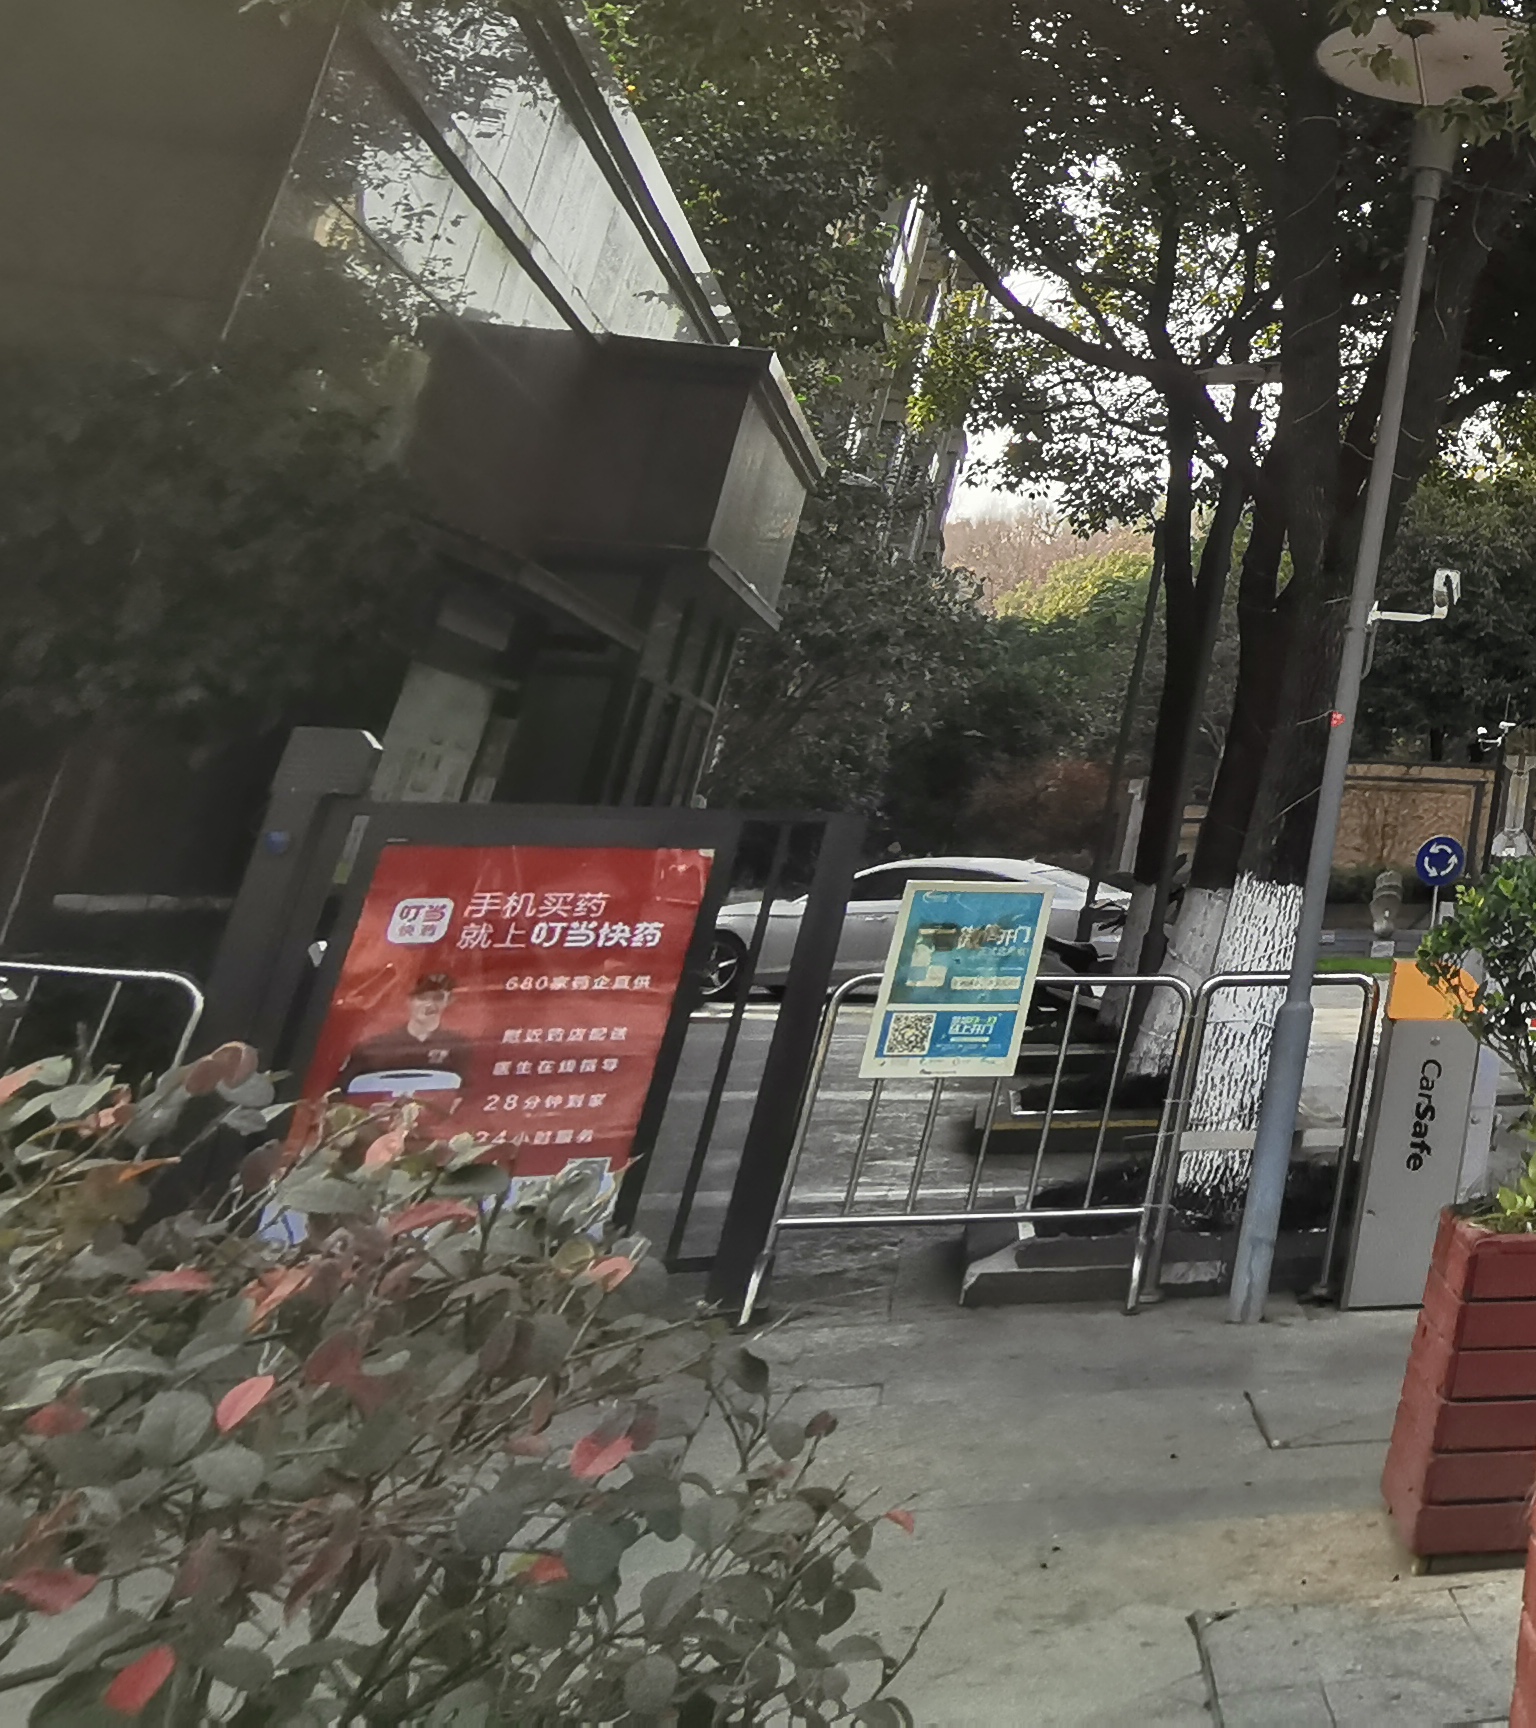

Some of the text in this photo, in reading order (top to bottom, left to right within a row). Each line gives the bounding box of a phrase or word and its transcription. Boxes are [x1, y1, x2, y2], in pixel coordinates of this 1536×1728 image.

[464, 892, 611, 919] 手机买药
[1406, 1059, 1442, 1172] CarSafe
